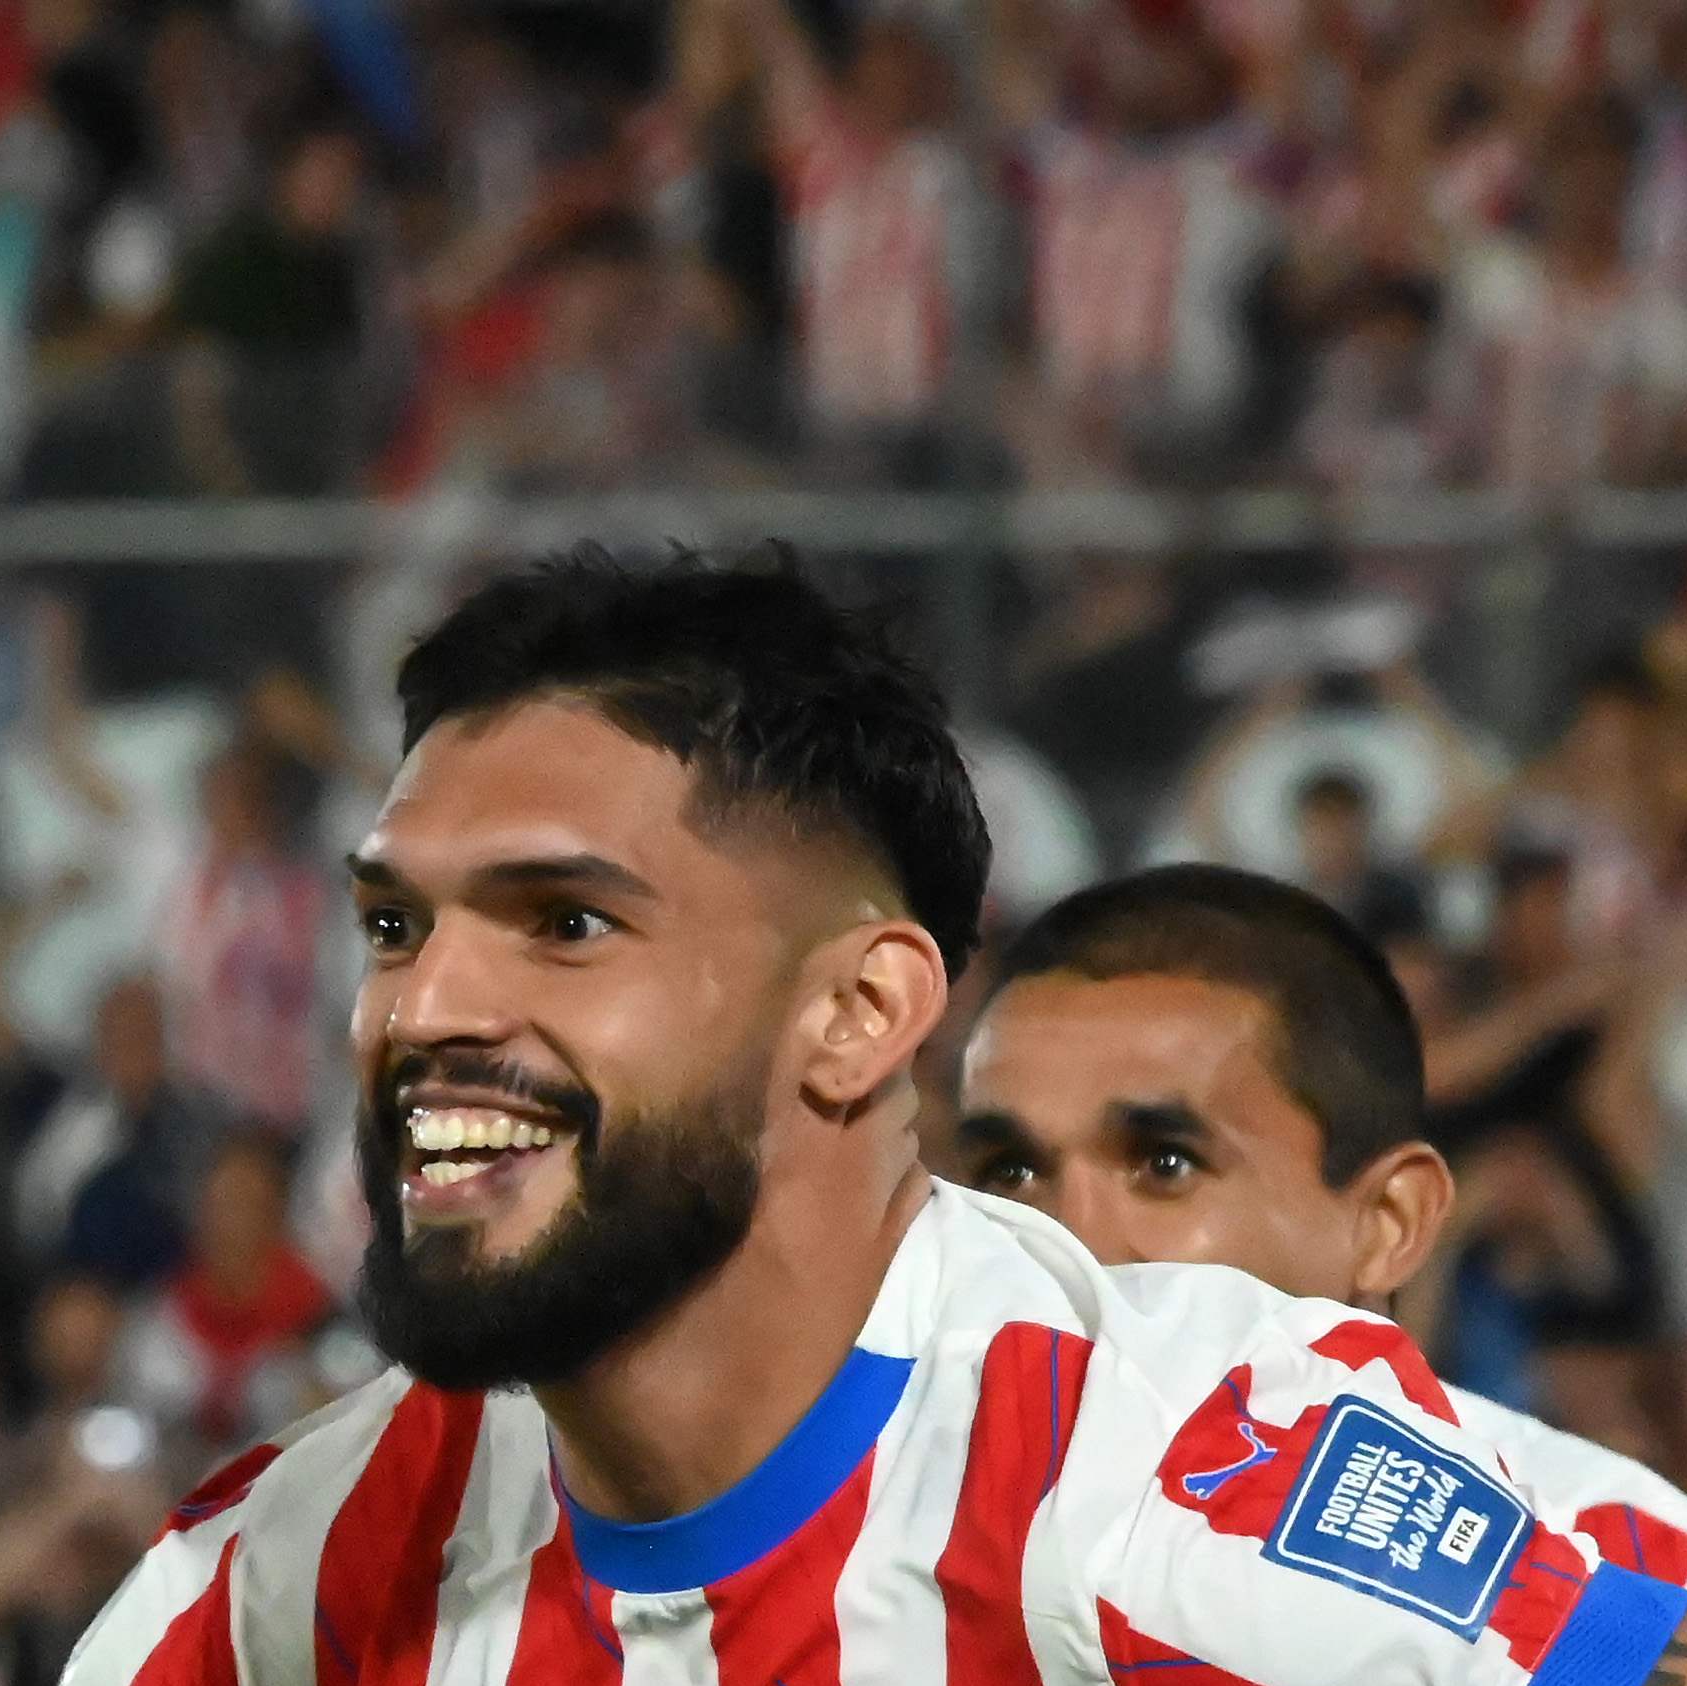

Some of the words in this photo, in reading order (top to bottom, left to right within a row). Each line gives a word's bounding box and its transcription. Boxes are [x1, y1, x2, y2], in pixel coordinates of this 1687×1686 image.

[1315, 1441, 1387, 1537] FOOTBALL
[1345, 1450, 1426, 1550] UNITES
[1404, 1465, 1465, 1533] World
[1388, 1530, 1428, 1571] the
[1449, 1518, 1479, 1553] FIFA
